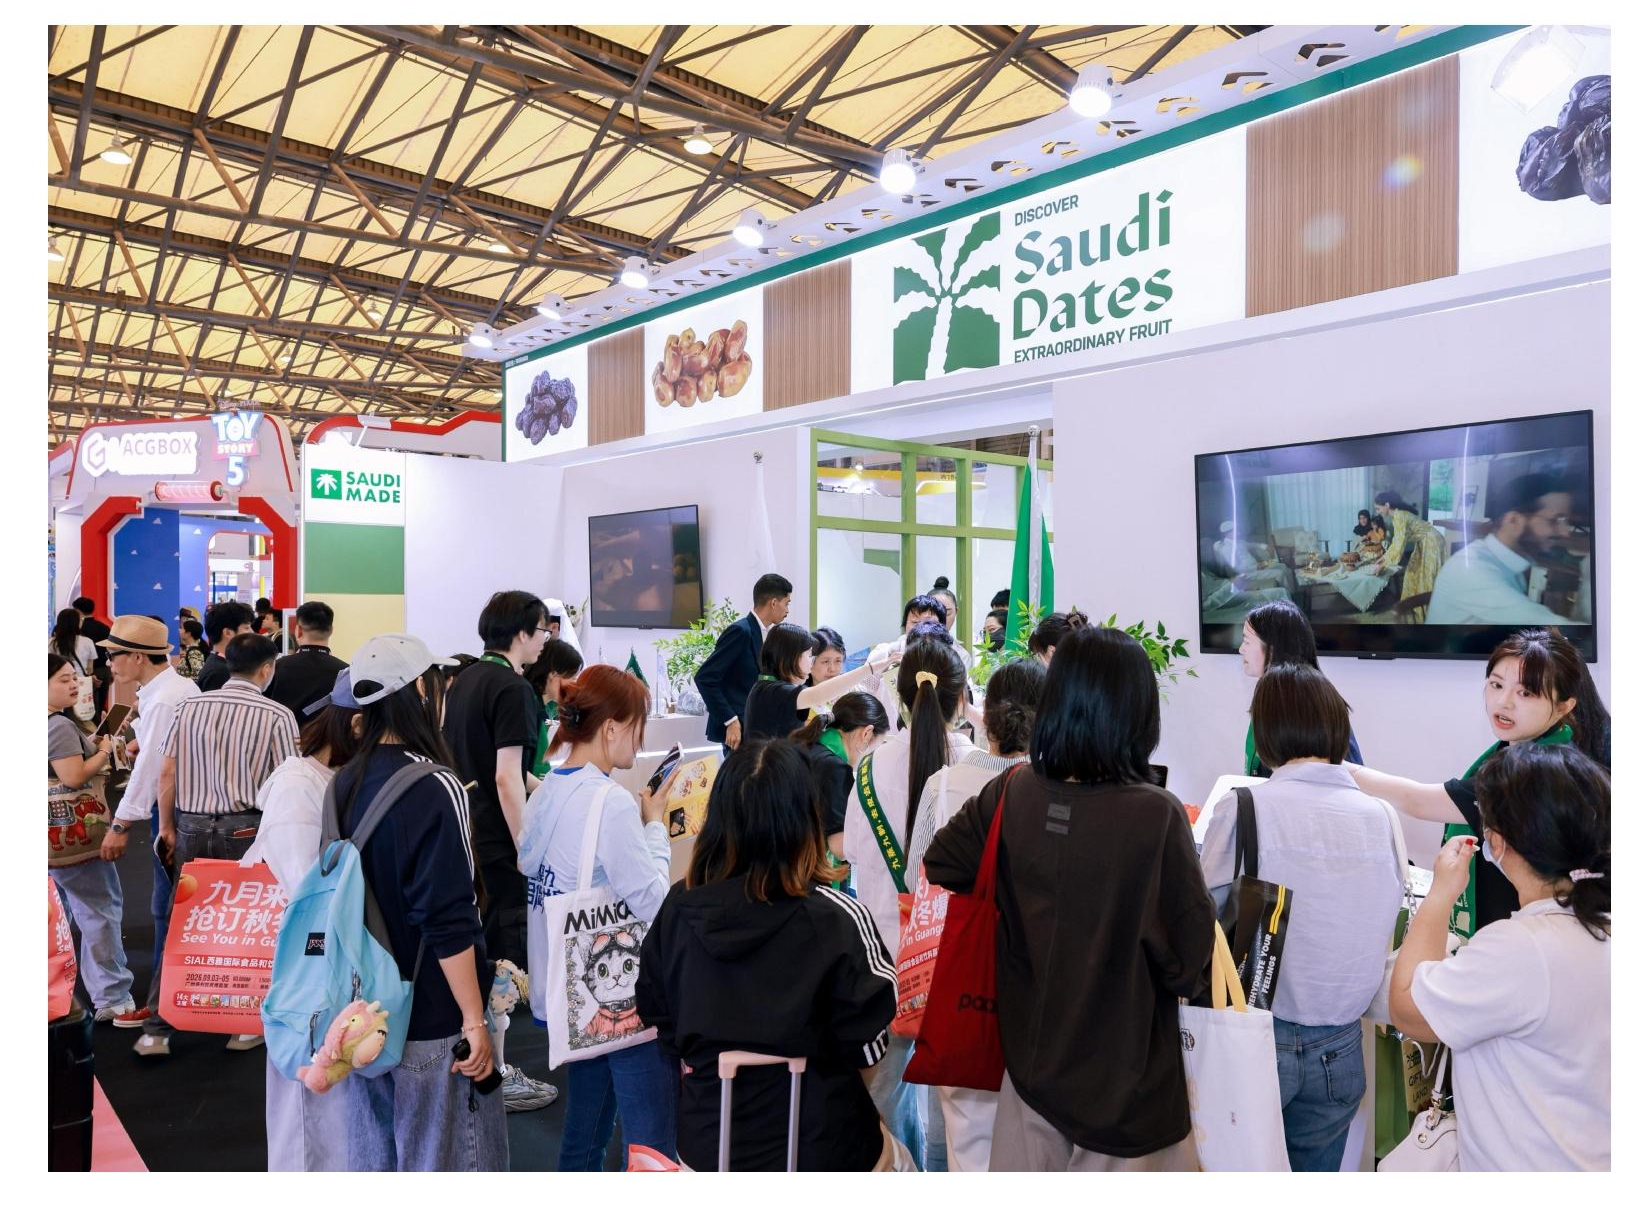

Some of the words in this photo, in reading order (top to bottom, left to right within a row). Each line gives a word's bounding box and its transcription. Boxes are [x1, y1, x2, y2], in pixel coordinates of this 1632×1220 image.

[1015, 194, 1079, 226] DISCOVER
[1014, 189, 1174, 284] Saudi
[1013, 268, 1173, 341] Dates
[1014, 329, 1125, 364] EXTRAORDINARY
[1129, 318, 1173, 342] FRUIT
[212, 412, 260, 443] TOY
[122, 437, 193, 458] ACGBOX
[217, 442, 255, 455] STORY
[227, 455, 245, 487] 5
[346, 471, 401, 487] SAUDI
[346, 486, 401, 504] MADE
[202, 880, 289, 908] 九月来
[181, 932, 208, 944] See
[212, 933, 238, 945] You
[241, 934, 255, 946] in
[1260, 933, 1273, 959] YOUR
[1261, 955, 1277, 995] FEELINGS
